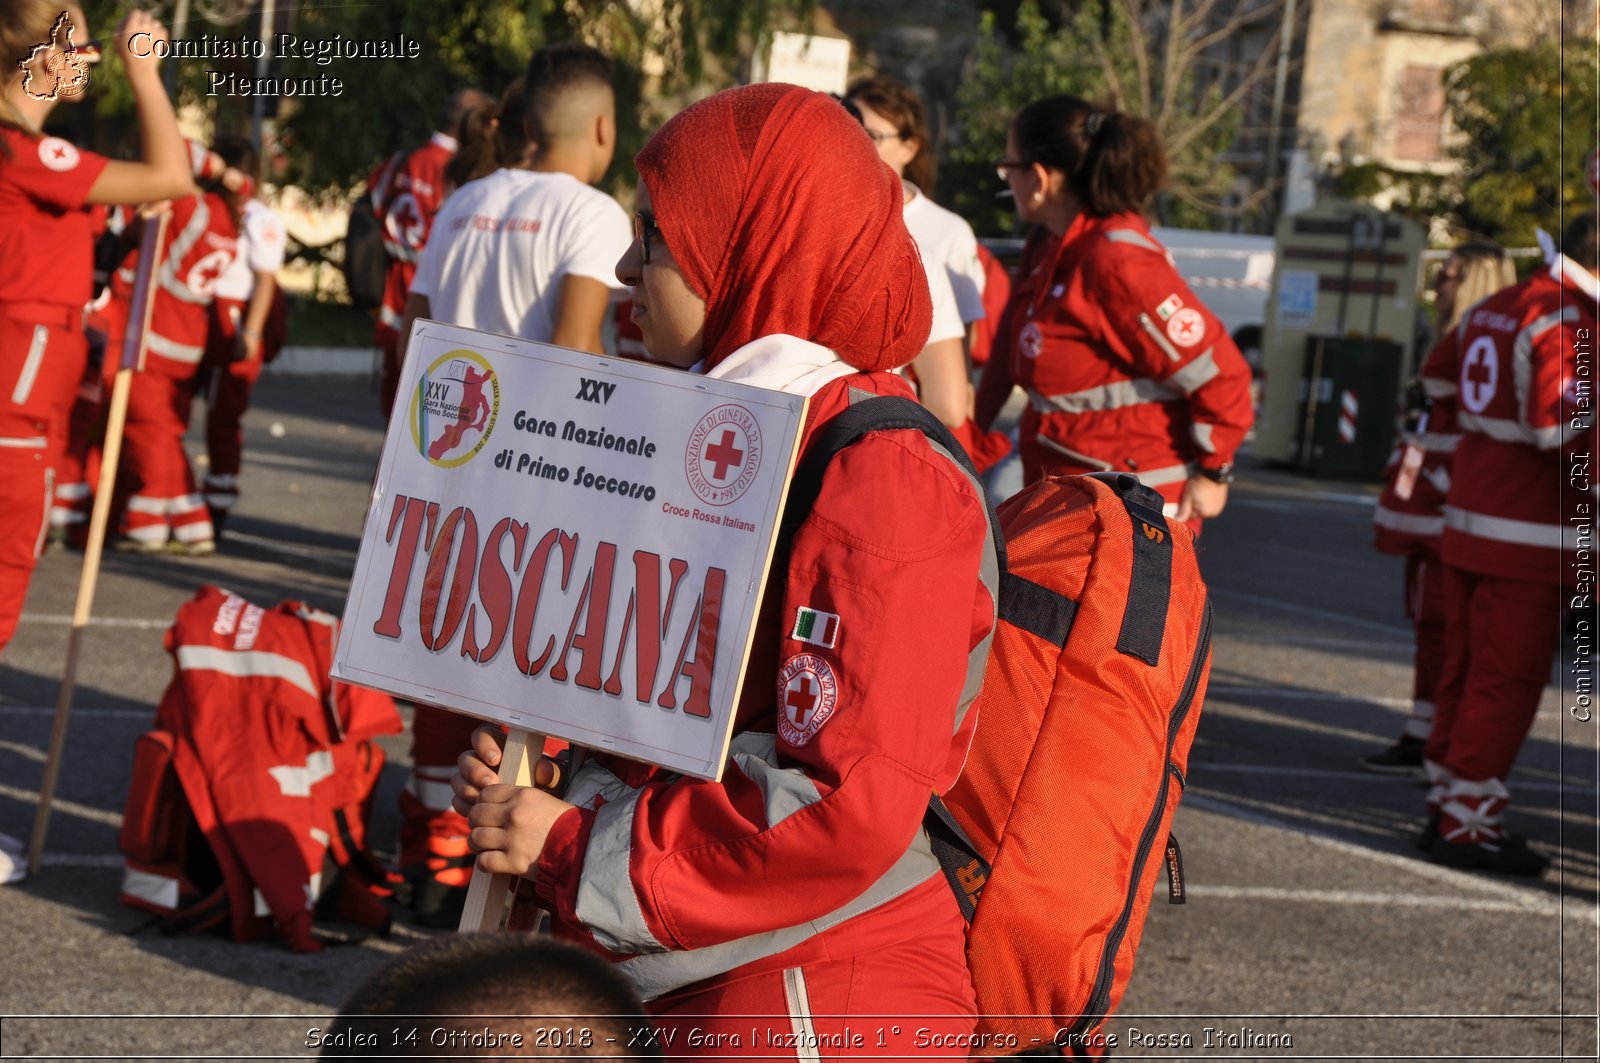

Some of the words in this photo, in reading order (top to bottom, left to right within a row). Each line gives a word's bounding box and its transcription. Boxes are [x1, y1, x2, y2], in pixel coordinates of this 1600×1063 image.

[424, 398, 439, 408] Gara
[425, 381, 450, 401] XXV
[575, 377, 617, 405] XXV
[423, 405, 441, 416] Primo
[706, 413, 718, 426] DI
[718, 408, 753, 433] GINEVRA
[514, 410, 557, 437] Gara
[562, 420, 656, 458] Nazionale
[748, 430, 758, 444] 22
[688, 425, 711, 498] CONVENZIONE
[738, 446, 758, 489] AGOSTO
[494, 449, 514, 470] di
[516, 453, 569, 482] Primo
[573, 466, 656, 501] Soccorso
[720, 487, 739, 501] 1864
[662, 502, 690, 518] Croce
[692, 508, 721, 525] Rossa
[722, 515, 756, 532] Italiana
[373, 494, 727, 718] TOSCANA
